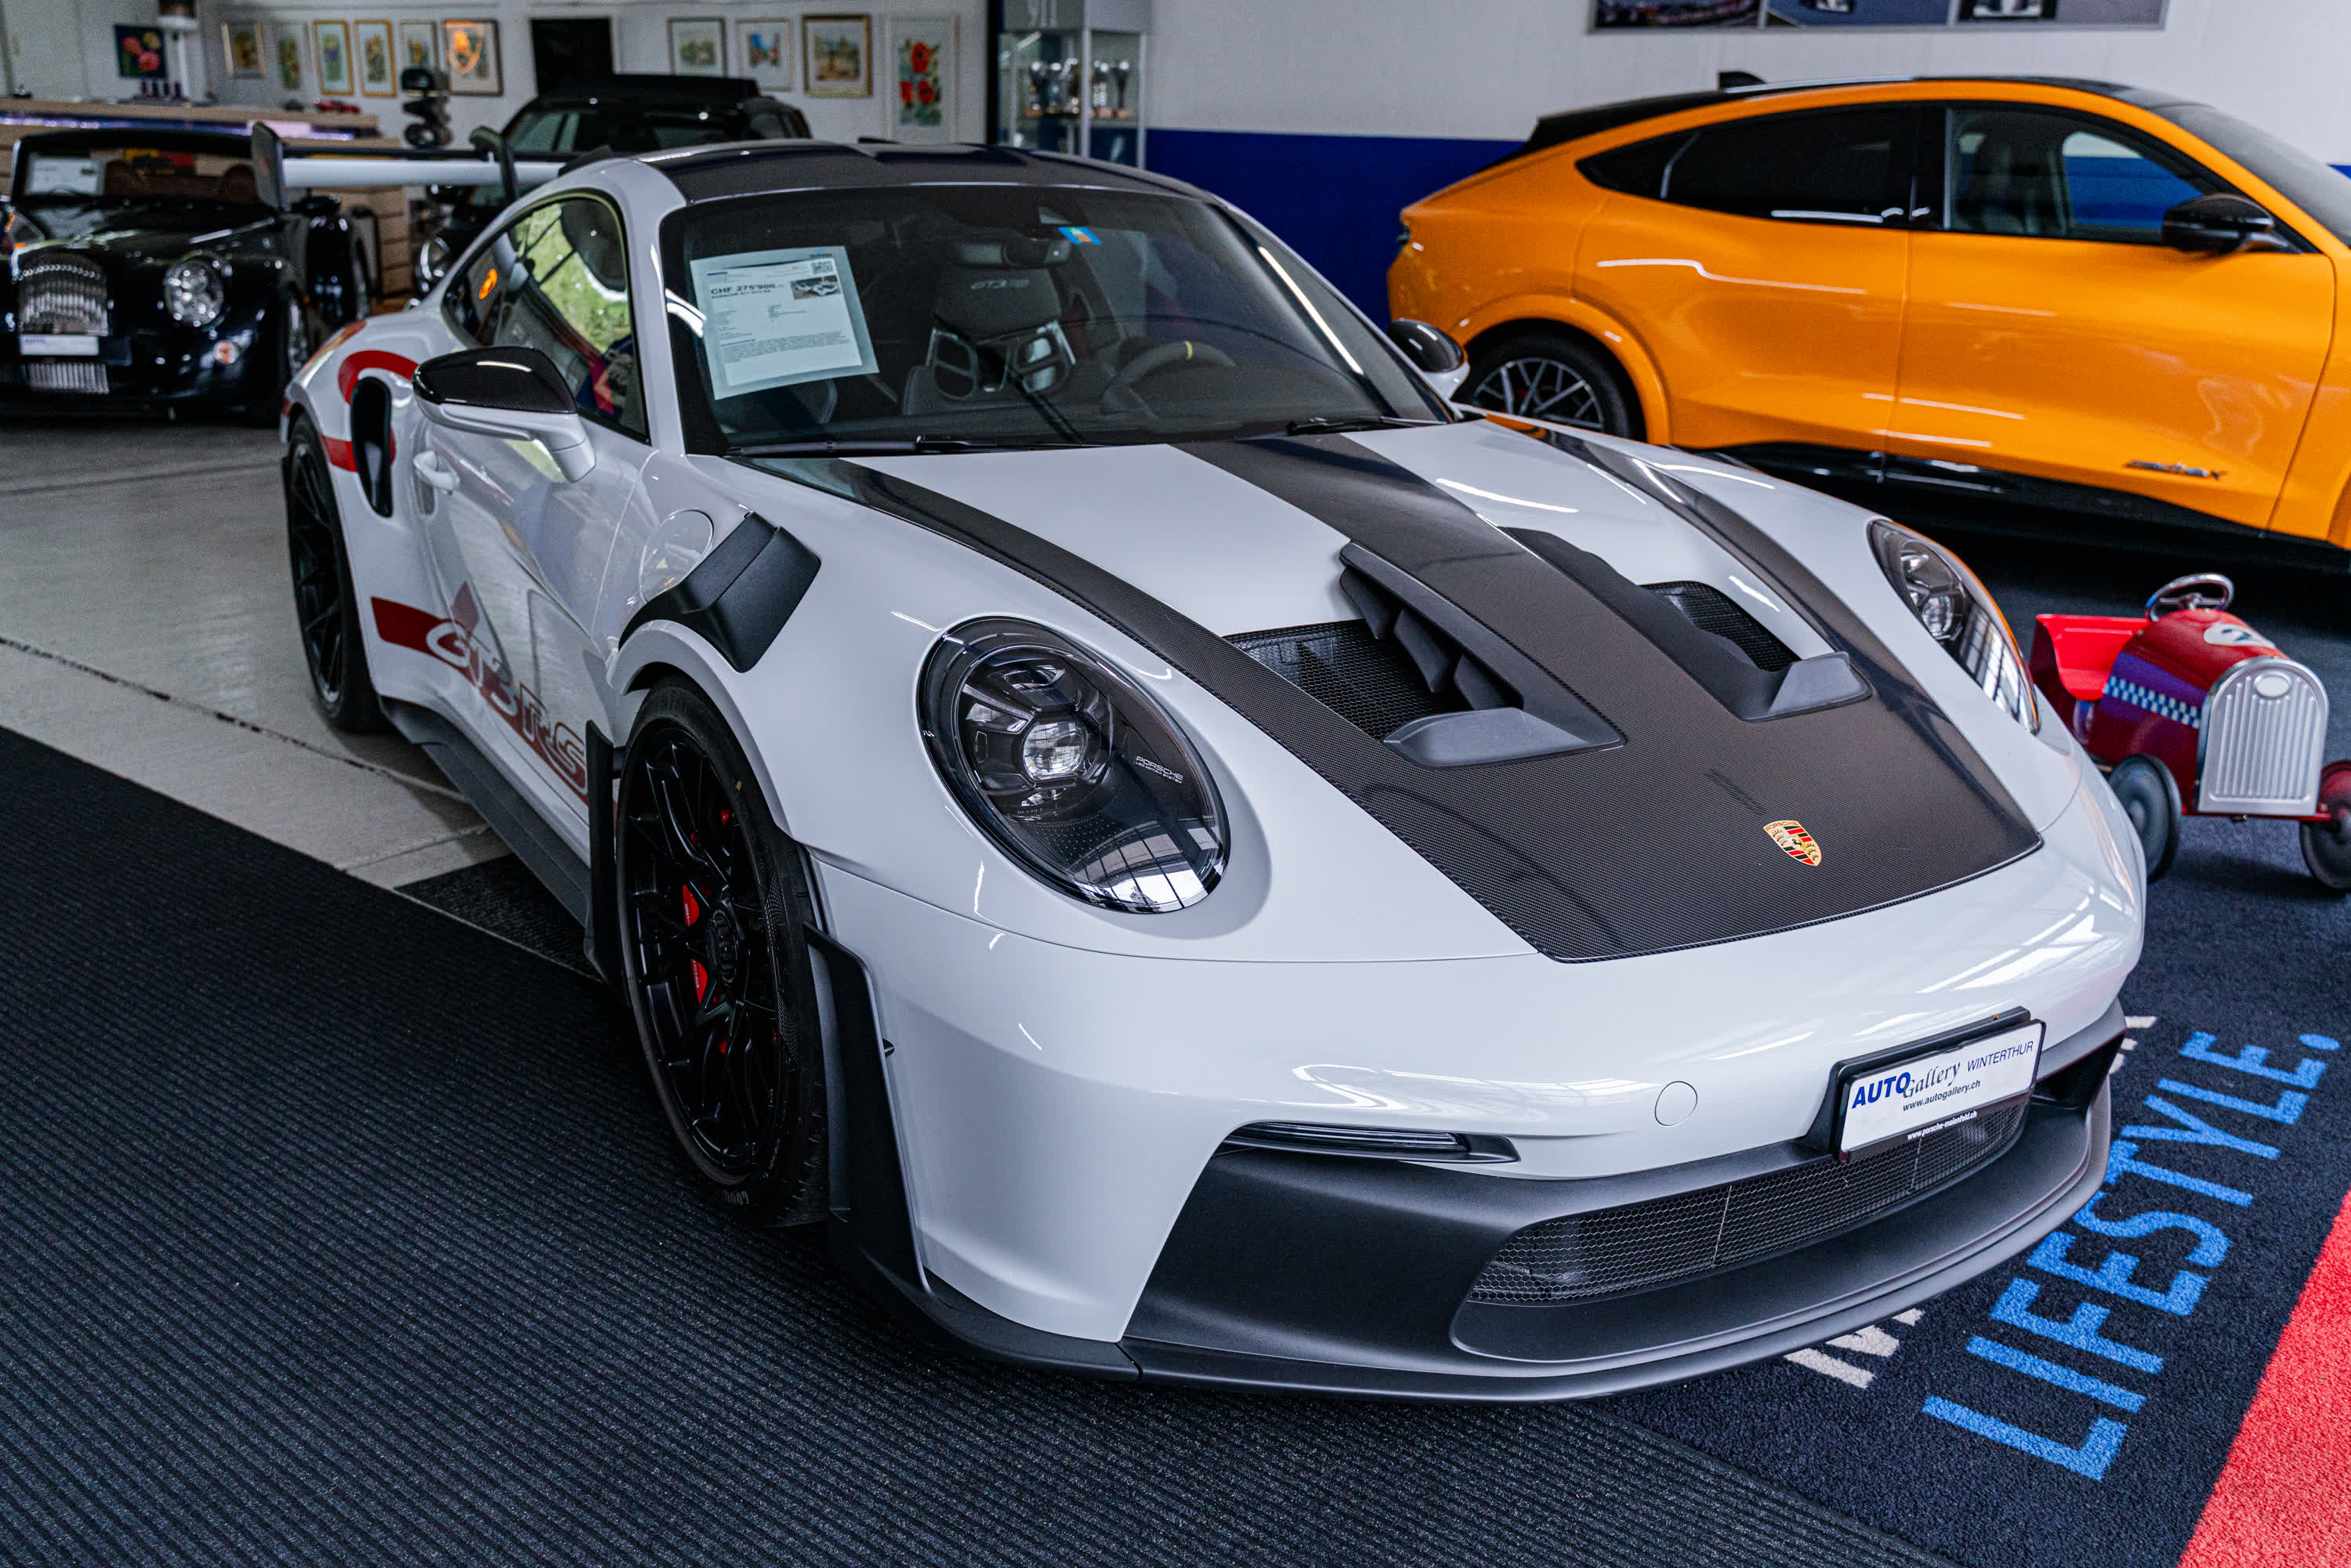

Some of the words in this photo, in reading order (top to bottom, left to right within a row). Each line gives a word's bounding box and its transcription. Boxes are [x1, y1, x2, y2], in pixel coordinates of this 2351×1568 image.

[1136, 756, 1183, 780] PORSCHE
[1766, 821, 1799, 831] PORSCHE
[1967, 1041, 2034, 1072] WINTERTHUR
[1902, 1079, 1981, 1112] www.autogallery.ch
[1907, 1111, 1978, 1140] www.porsche-maienfeld.ch
